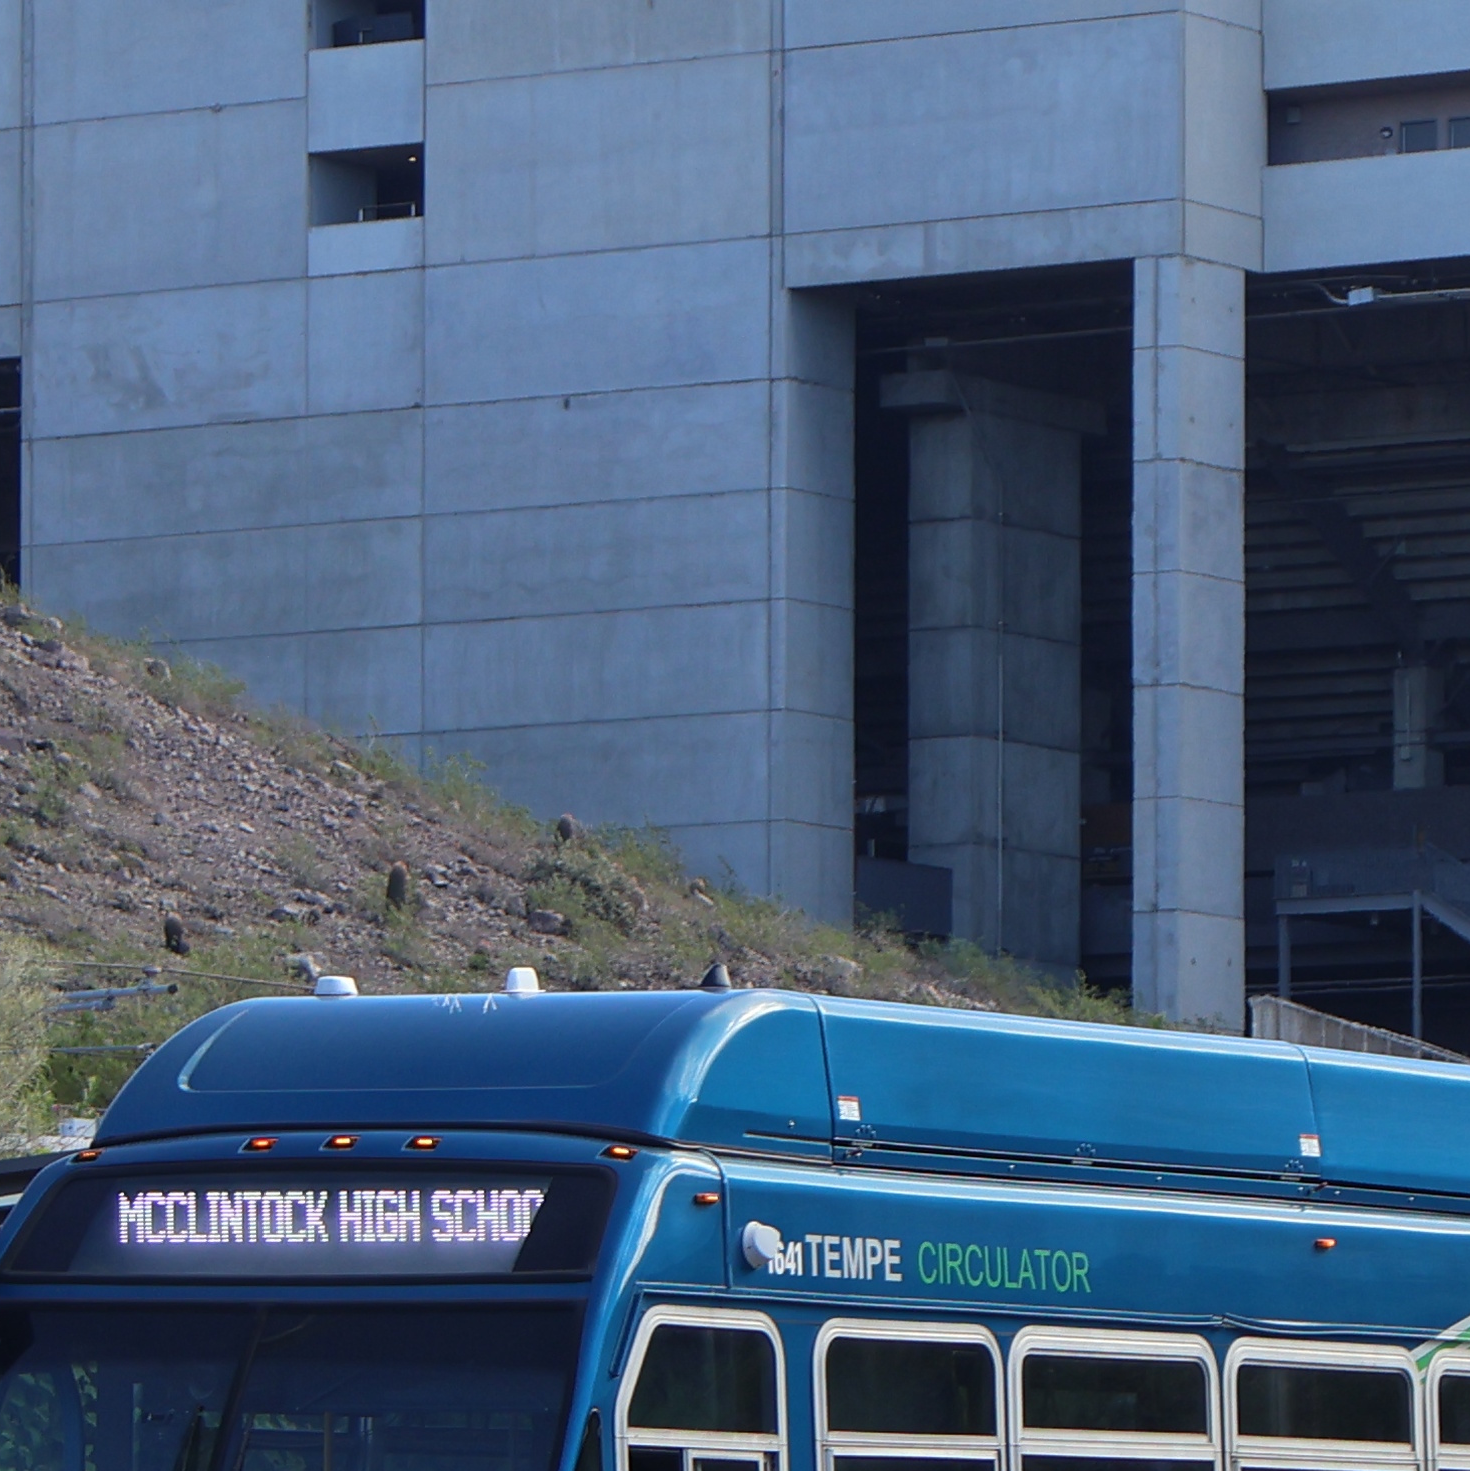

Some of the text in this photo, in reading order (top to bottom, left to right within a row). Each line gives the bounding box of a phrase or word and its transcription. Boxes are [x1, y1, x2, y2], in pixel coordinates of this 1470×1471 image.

[118, 1191, 329, 1243] MCCLINTOCK
[338, 1190, 421, 1242] HIGH
[805, 1234, 903, 1282] TEMPE
[918, 1241, 1092, 1293] CIRCULATOR
